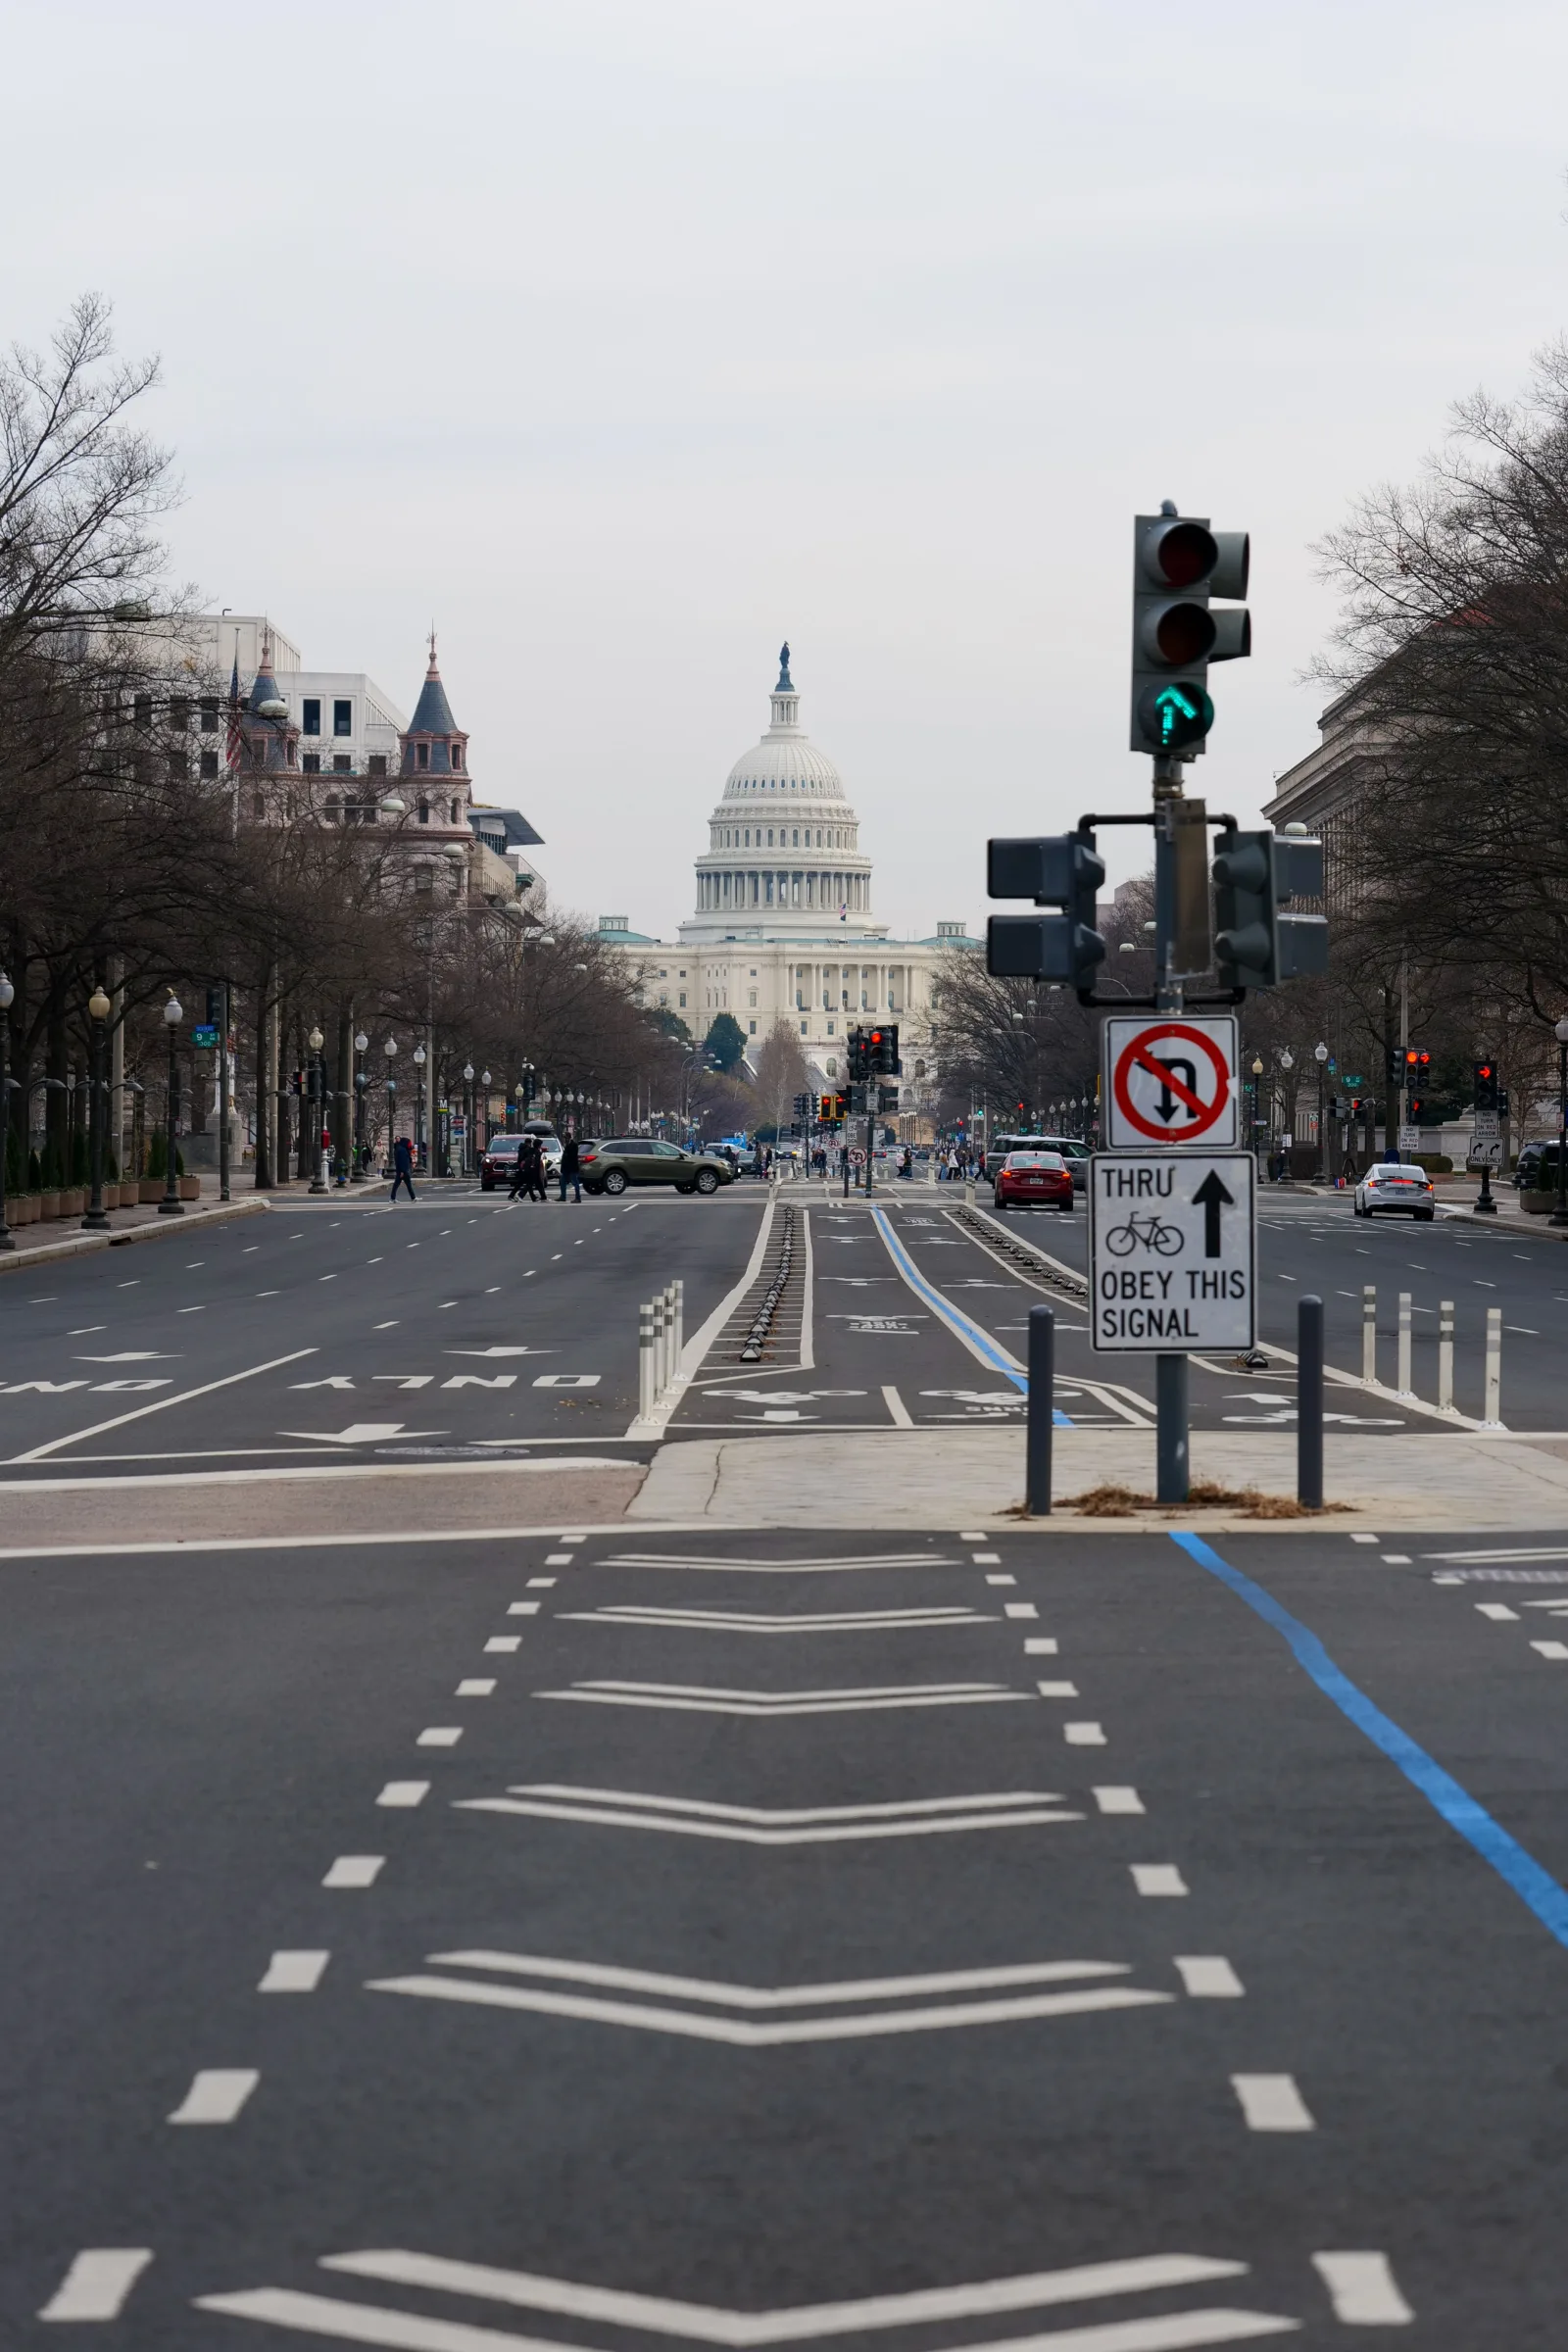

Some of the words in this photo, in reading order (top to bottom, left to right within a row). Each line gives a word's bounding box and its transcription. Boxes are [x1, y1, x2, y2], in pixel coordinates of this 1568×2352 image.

[439, 1099, 448, 1108] M
[1101, 1167, 1173, 1198] THRU
[1101, 1270, 1174, 1300] OBEY
[1185, 1269, 1246, 1299] THIS
[1102, 1307, 1200, 1338] SIGNAL
[286, 1374, 603, 1389] ONLY
